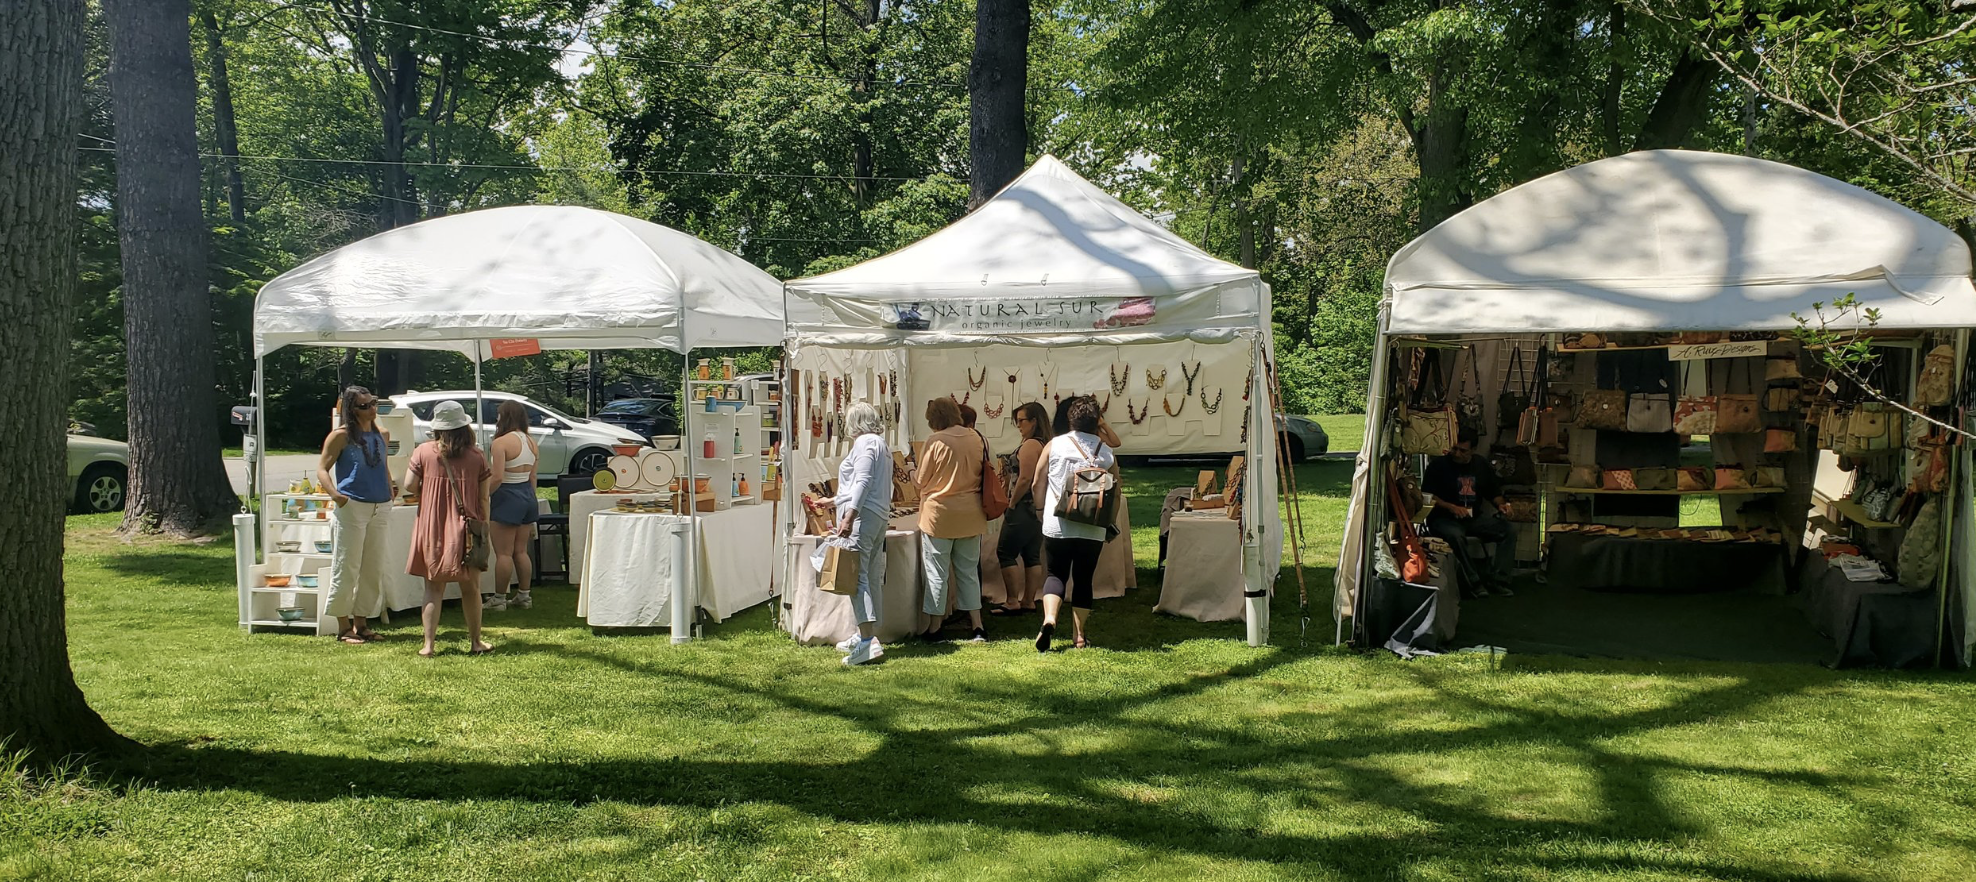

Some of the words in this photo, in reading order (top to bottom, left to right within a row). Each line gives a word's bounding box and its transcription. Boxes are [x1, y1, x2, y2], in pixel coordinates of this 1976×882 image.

[931, 302, 1043, 317] NATURAL
[1059, 301, 1103, 315] SUR
[962, 320, 1012, 330] organic
[1020, 318, 1072, 330] jewelry
